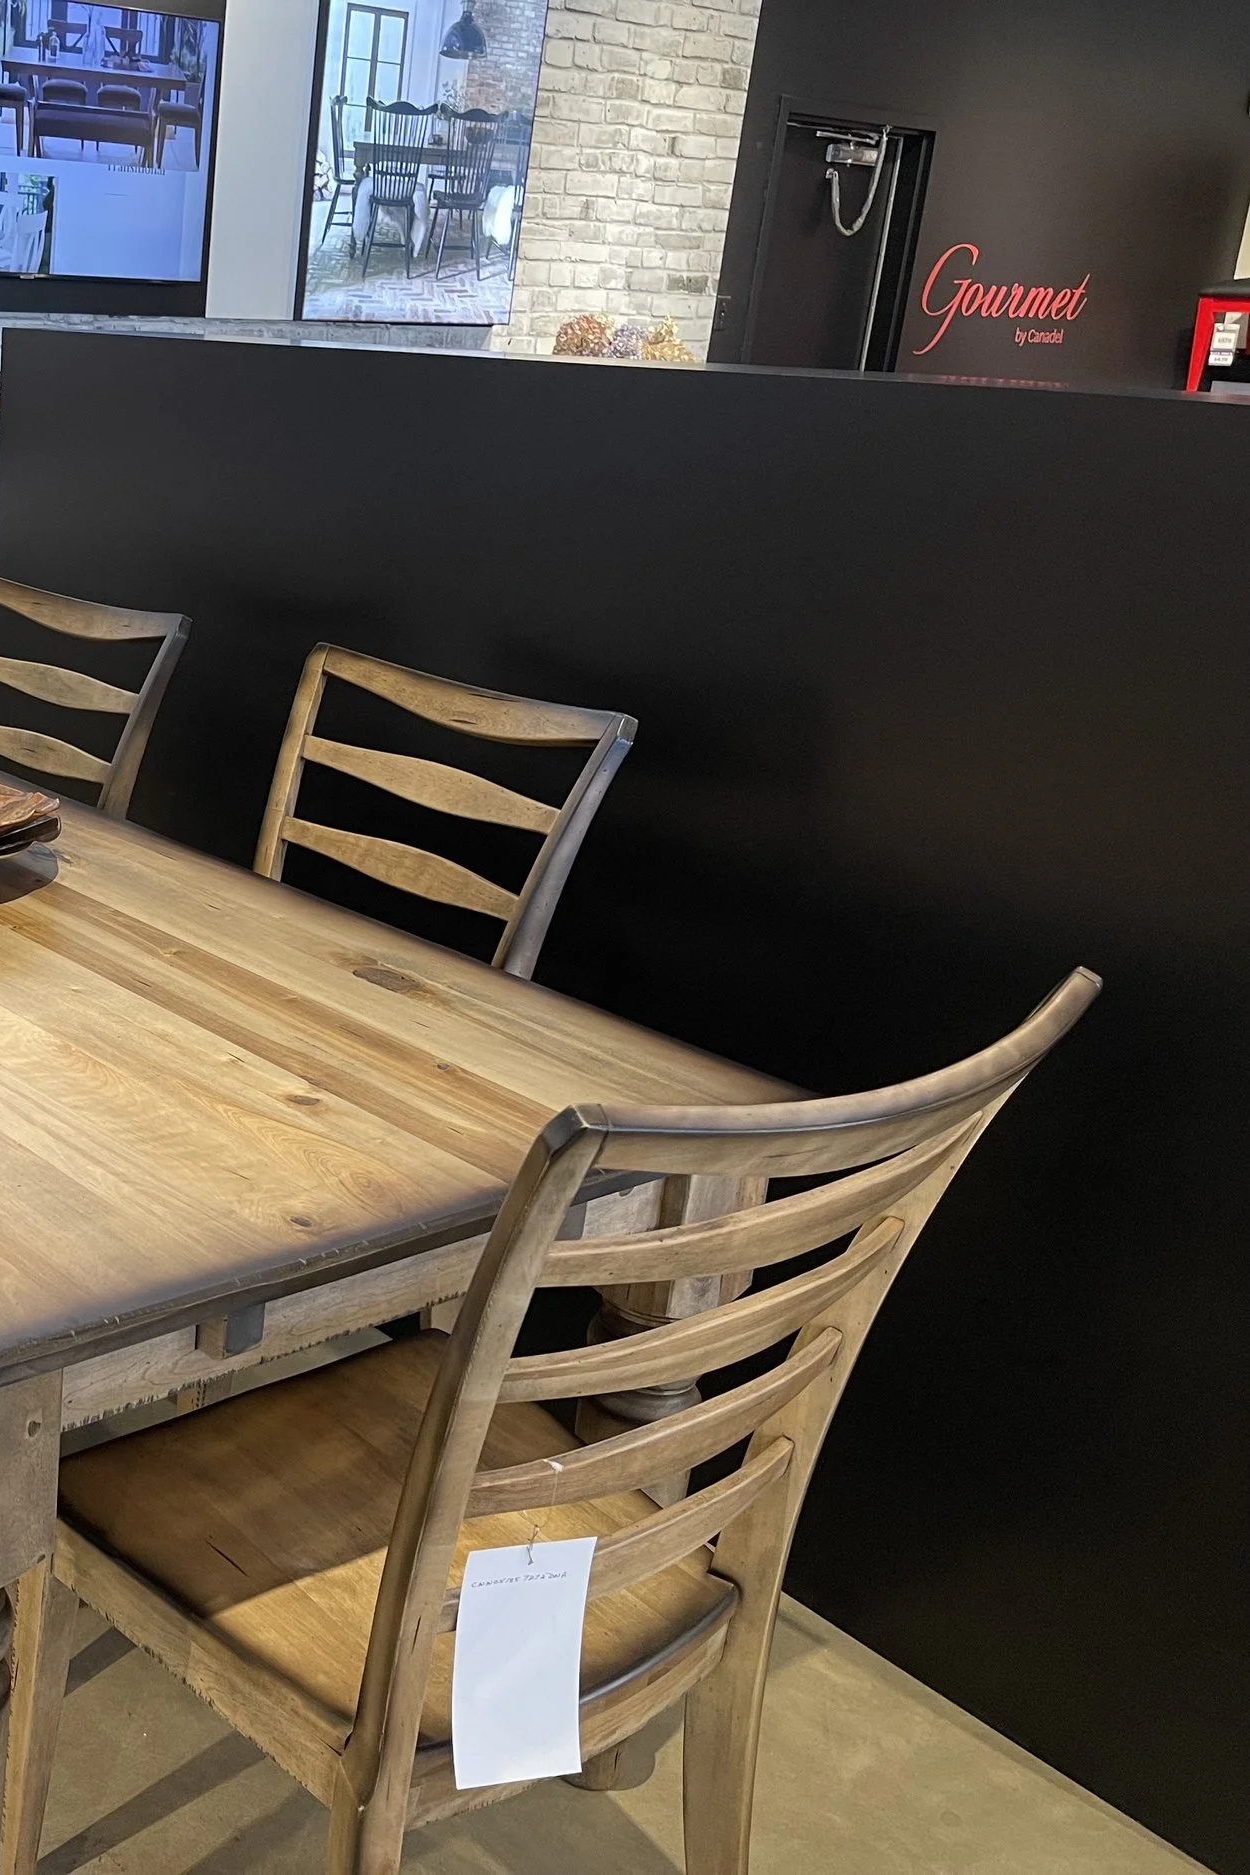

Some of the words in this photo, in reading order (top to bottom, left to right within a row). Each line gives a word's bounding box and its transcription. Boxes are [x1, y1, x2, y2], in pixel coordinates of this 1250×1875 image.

[912, 243, 1091, 355] Gourmet
[1014, 327, 1027, 347] by
[1027, 328, 1064, 344] Canadel
